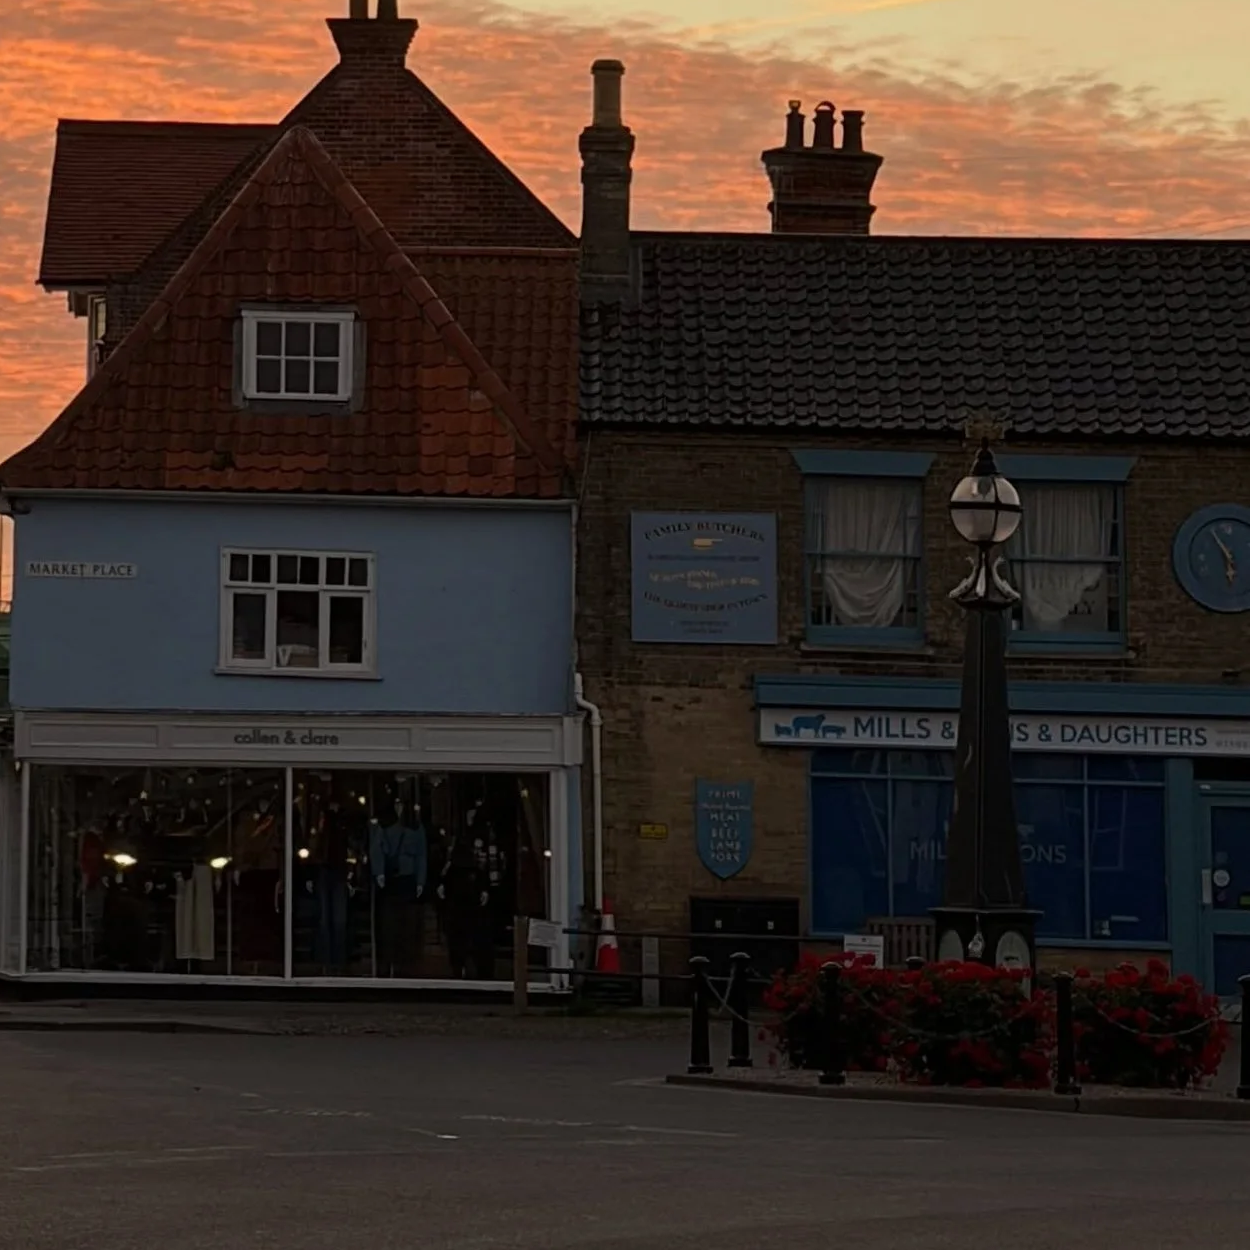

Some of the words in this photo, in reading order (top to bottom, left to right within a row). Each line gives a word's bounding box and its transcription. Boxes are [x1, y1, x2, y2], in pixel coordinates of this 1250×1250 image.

[644, 521, 690, 541] FAMILY
[697, 521, 766, 542] BUTCHERS
[29, 563, 86, 576] MARKET
[93, 564, 133, 576] PLACE
[283, 730, 297, 745] &
[300, 729, 339, 745] clare
[854, 716, 931, 739] MILLS
[941, 721, 955, 739] &
[1038, 723, 1052, 743] &
[1061, 724, 1208, 747] DAUGHTERS
[910, 839, 948, 860] MIL
[1020, 843, 1067, 864] ONS
